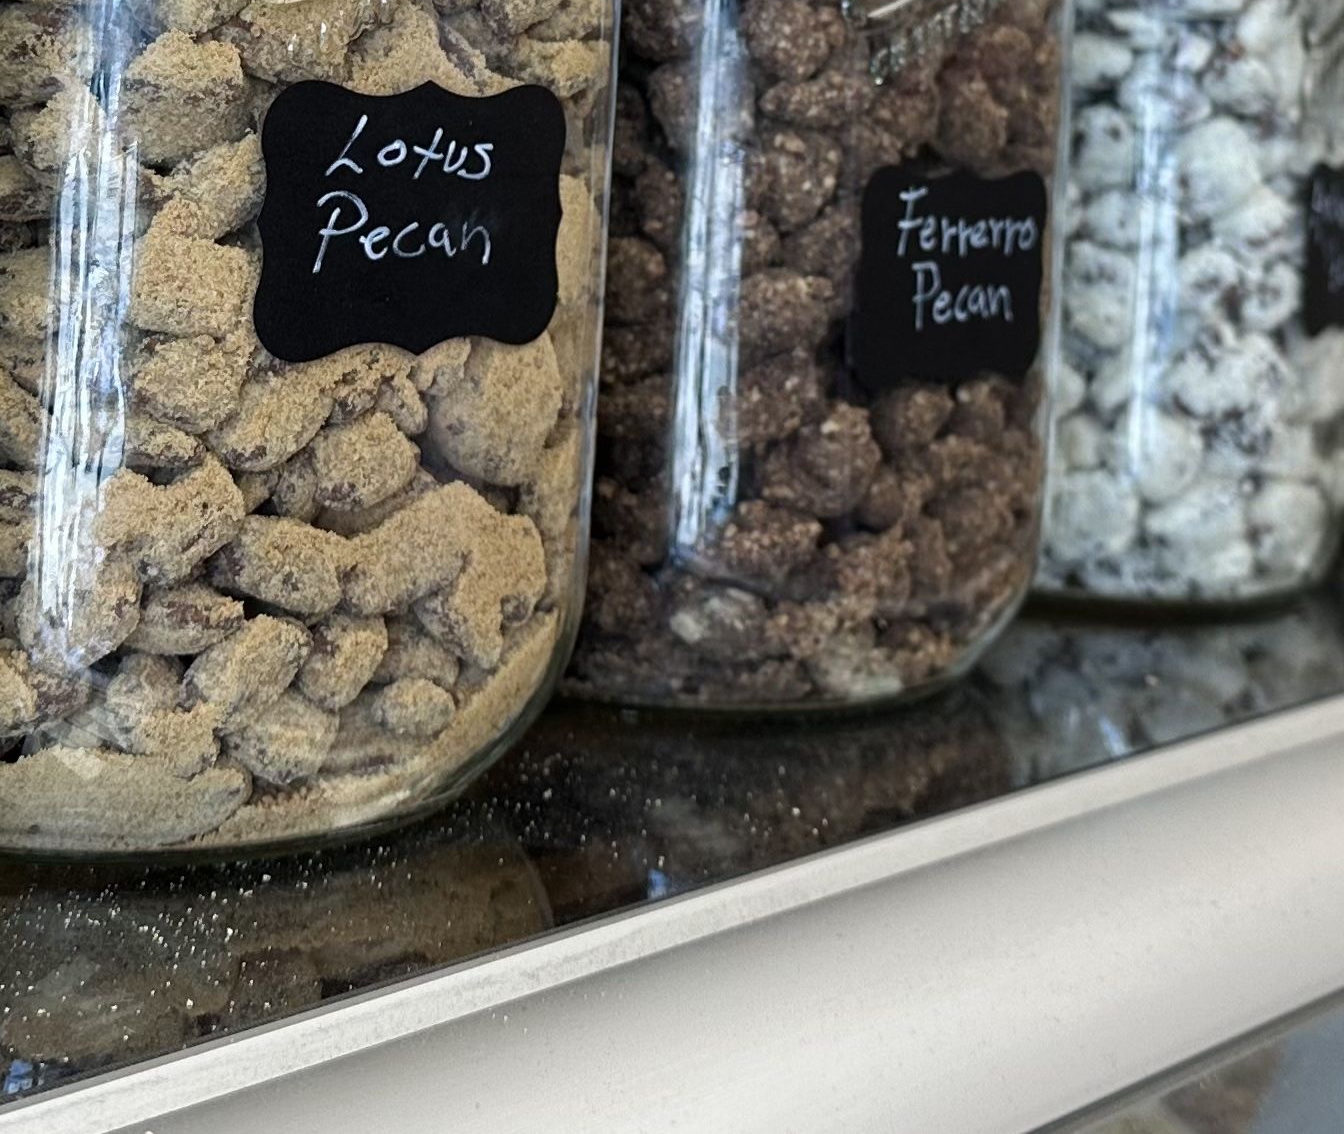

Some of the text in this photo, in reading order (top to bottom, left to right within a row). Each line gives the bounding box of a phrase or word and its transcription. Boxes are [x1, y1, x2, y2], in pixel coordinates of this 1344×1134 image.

[324, 114, 494, 180] Lotus
[312, 190, 492, 274] Pecan
[911, 260, 1014, 331] Pecan
